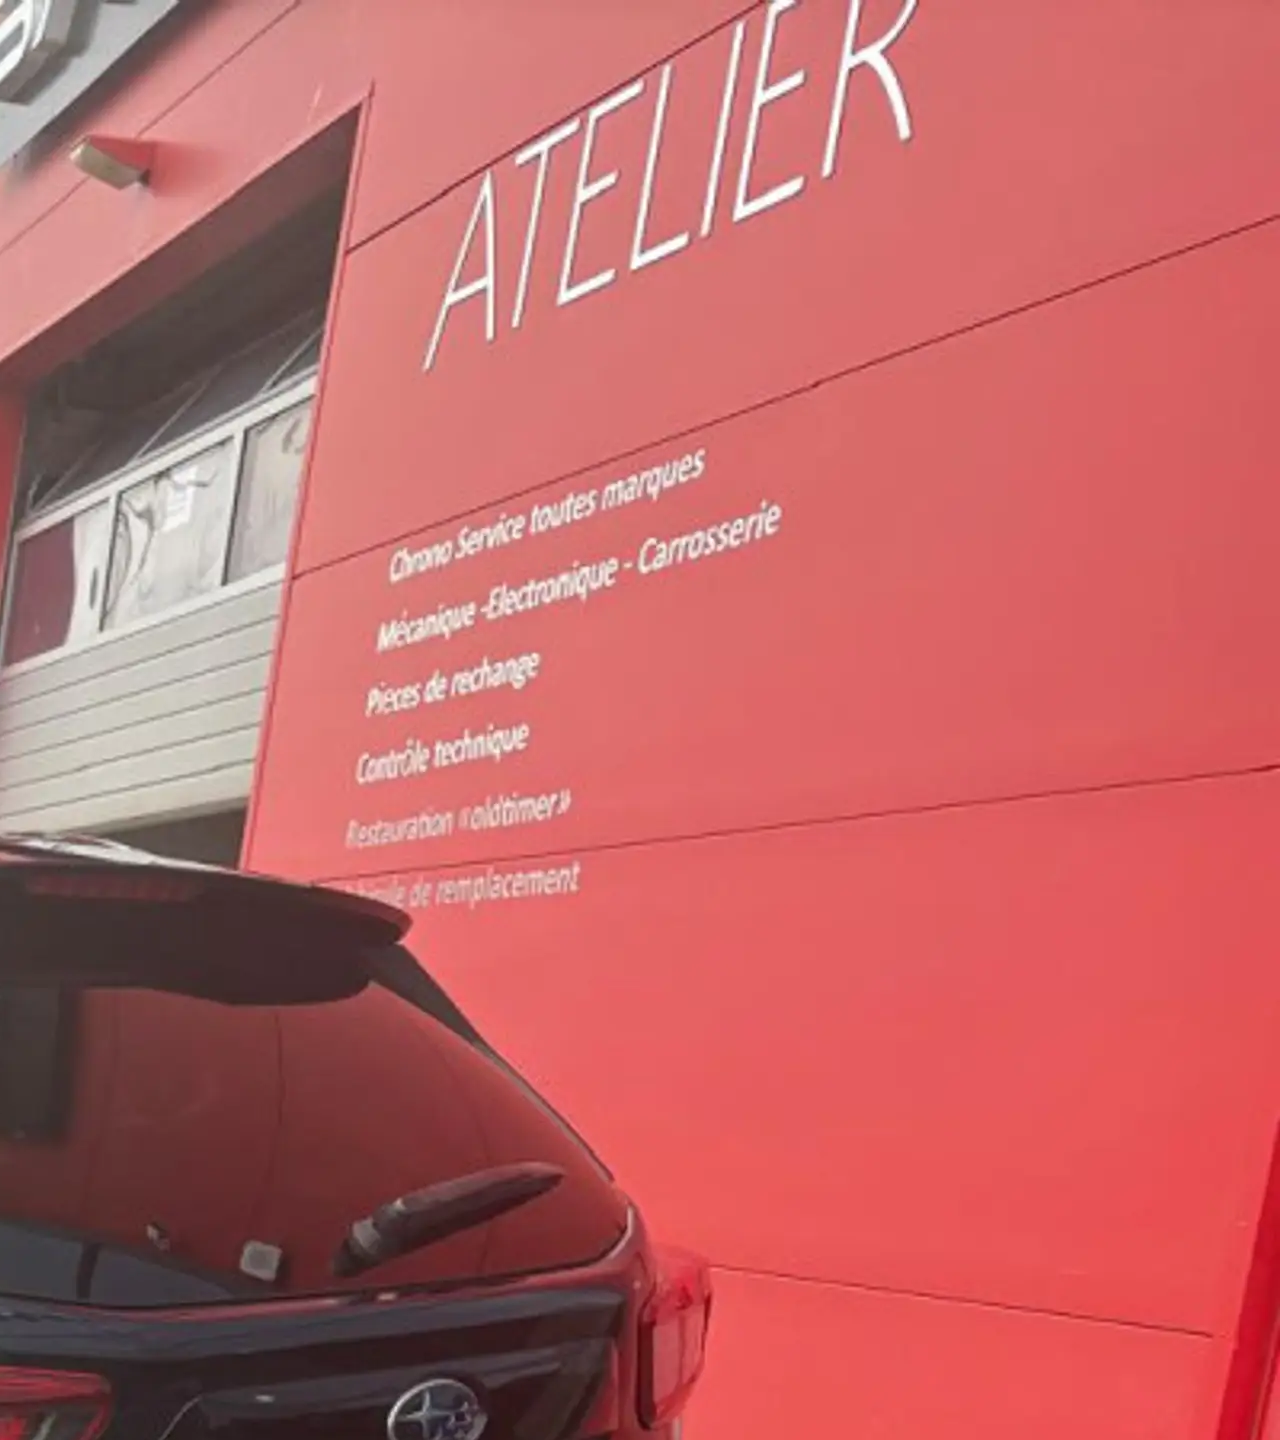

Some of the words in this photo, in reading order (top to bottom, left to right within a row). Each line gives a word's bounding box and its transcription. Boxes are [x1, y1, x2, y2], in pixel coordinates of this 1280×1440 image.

[423, 0, 916, 371] ATELIER
[389, 539, 454, 584] Chrono
[455, 512, 526, 560] Service
[529, 488, 599, 534] toutes
[601, 447, 706, 510] marques
[376, 601, 477, 654] Mécanique
[637, 497, 783, 575] Carrosserie
[422, 668, 448, 704] de
[450, 651, 542, 697] rechange
[355, 738, 432, 785] Contrôle
[433, 721, 531, 769] technique
[345, 806, 454, 851] Restauration
[434, 860, 582, 912] remplacement
